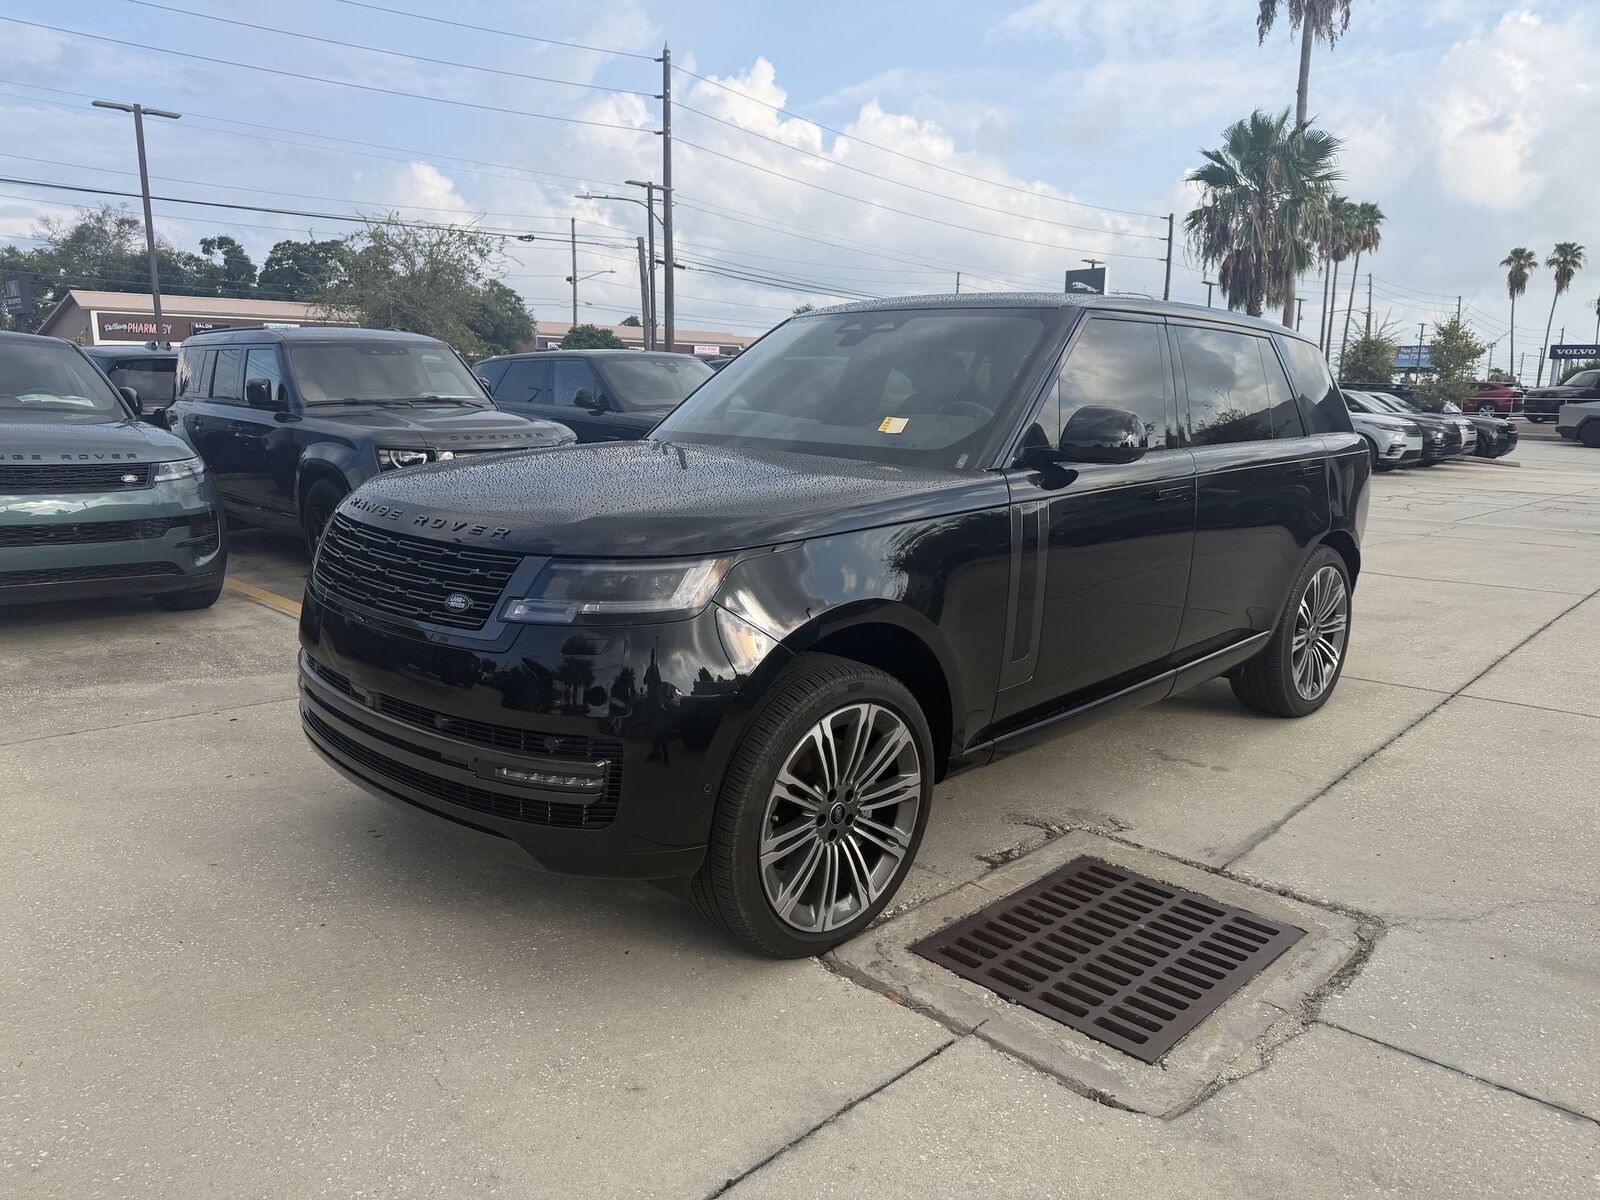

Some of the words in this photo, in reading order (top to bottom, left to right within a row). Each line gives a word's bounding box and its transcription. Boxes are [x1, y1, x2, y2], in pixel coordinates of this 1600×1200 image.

[450, 432, 544, 441] DEFENDER
[351, 498, 403, 520] RANGE
[414, 514, 511, 539] ROVER
